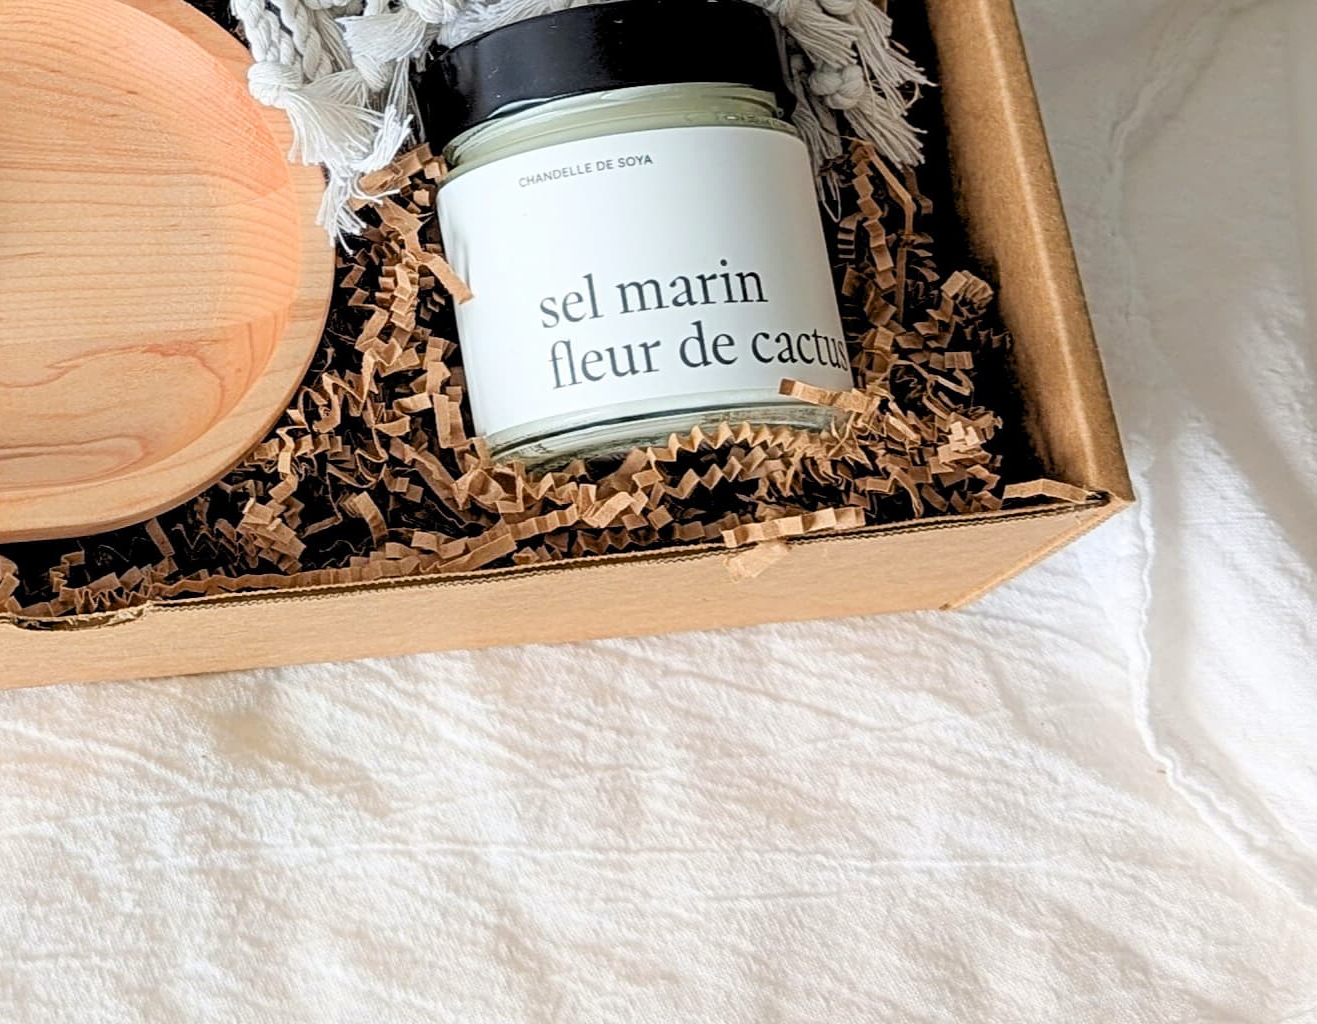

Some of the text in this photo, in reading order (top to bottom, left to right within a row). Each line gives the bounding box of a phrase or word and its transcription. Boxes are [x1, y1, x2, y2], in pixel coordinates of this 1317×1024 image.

[518, 154, 653, 188] CHANDELLE DE SOYA
[539, 258, 769, 329] sel marin
[548, 319, 849, 390] fleur de cactus
